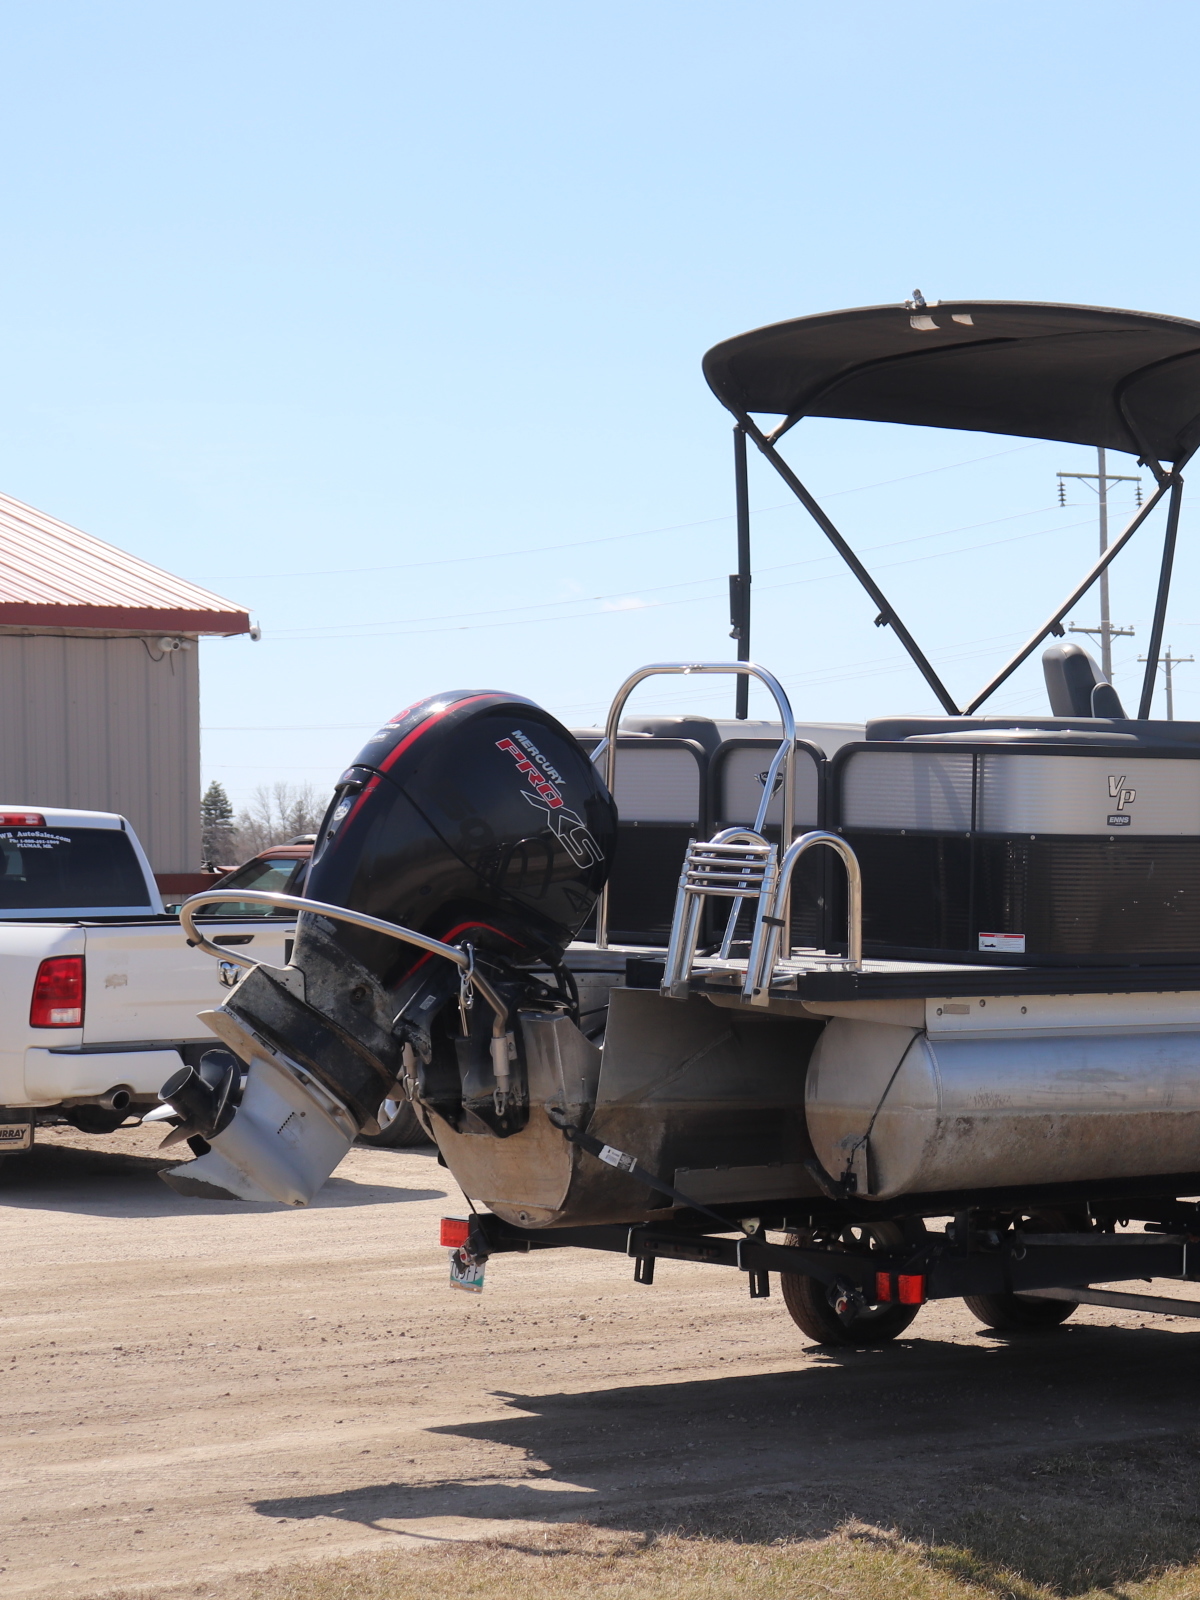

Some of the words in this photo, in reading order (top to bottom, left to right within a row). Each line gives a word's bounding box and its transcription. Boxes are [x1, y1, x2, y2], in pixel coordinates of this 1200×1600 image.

[495, 737, 564, 809] PRO
[511, 729, 567, 786] MERCURY
[16, 830, 72, 843] AutoSales.com
[519, 789, 605, 870] XS
